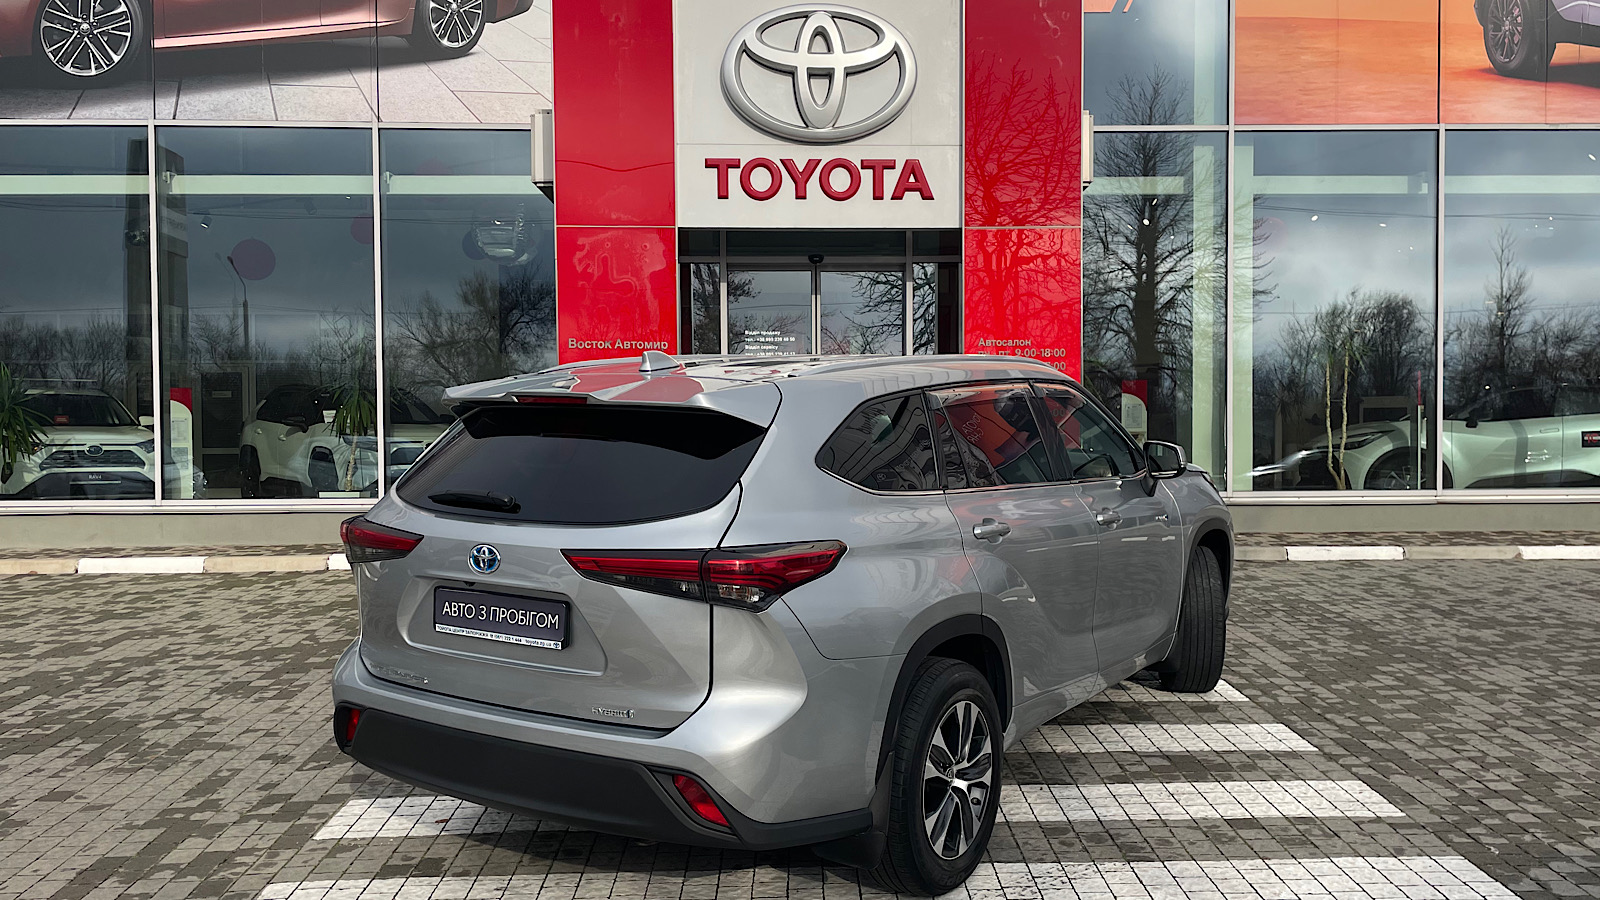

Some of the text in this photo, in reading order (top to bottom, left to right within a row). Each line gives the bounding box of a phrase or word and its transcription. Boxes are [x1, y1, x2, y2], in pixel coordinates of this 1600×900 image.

[705, 157, 935, 201] TOYOTA
[568, 338, 669, 351] Восток Автомир
[978, 338, 1031, 347] Автосалон
[442, 601, 476, 619] АВТО
[490, 607, 559, 629] ПРОБІГОМ
